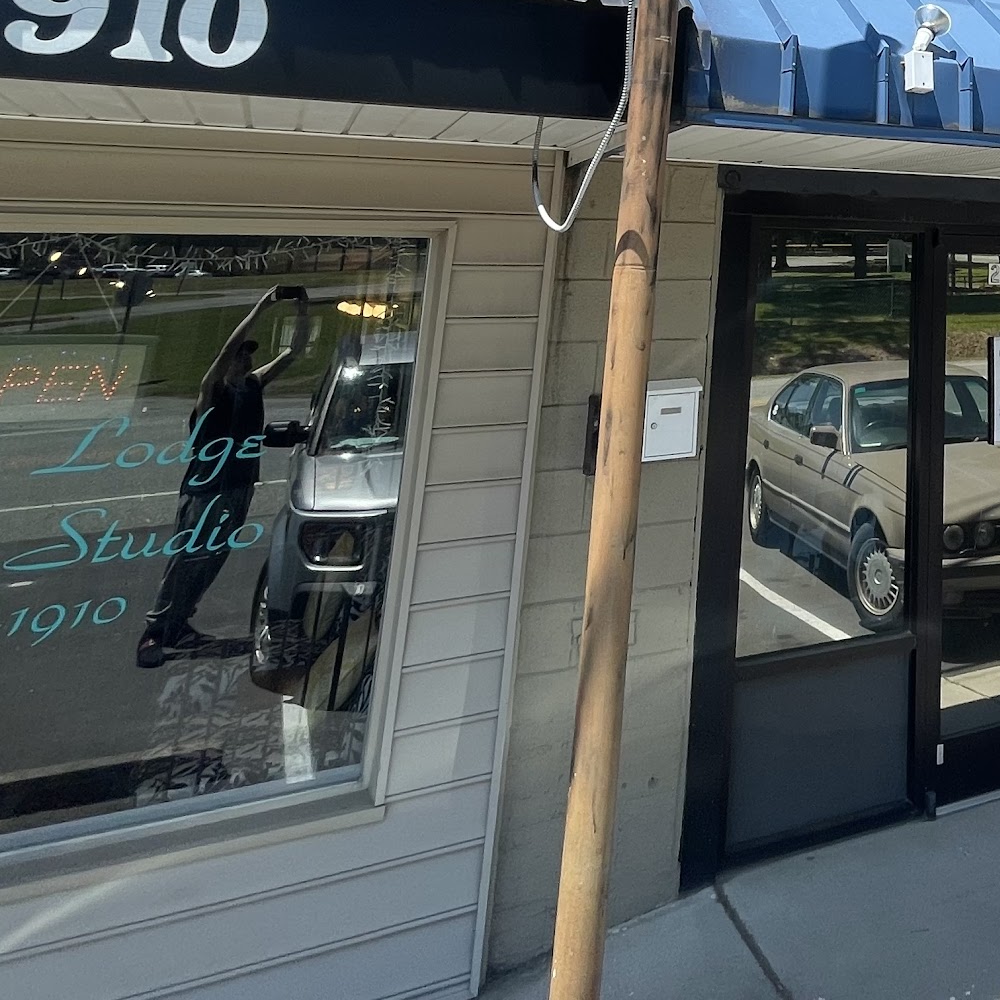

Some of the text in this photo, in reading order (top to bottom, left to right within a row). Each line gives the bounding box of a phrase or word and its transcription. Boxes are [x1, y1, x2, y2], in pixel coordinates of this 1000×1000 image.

[30, 407, 268, 487] Lodge
[3, 507, 264, 574] Studio
[6, 596, 127, 647] 1910
